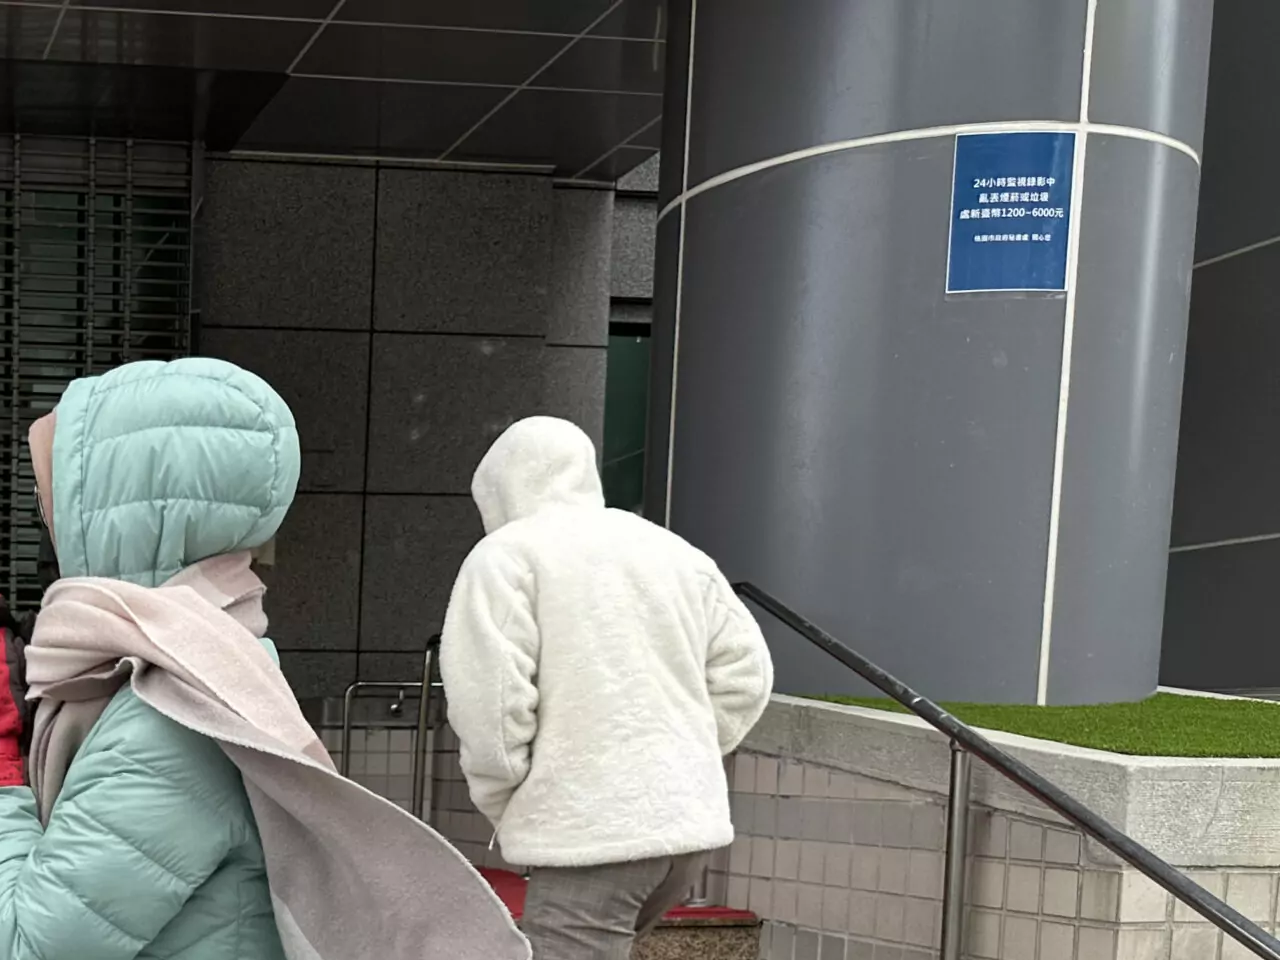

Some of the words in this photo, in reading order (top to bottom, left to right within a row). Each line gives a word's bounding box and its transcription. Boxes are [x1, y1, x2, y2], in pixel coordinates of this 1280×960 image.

[973, 176, 1056, 188] 24小時監視錄影中
